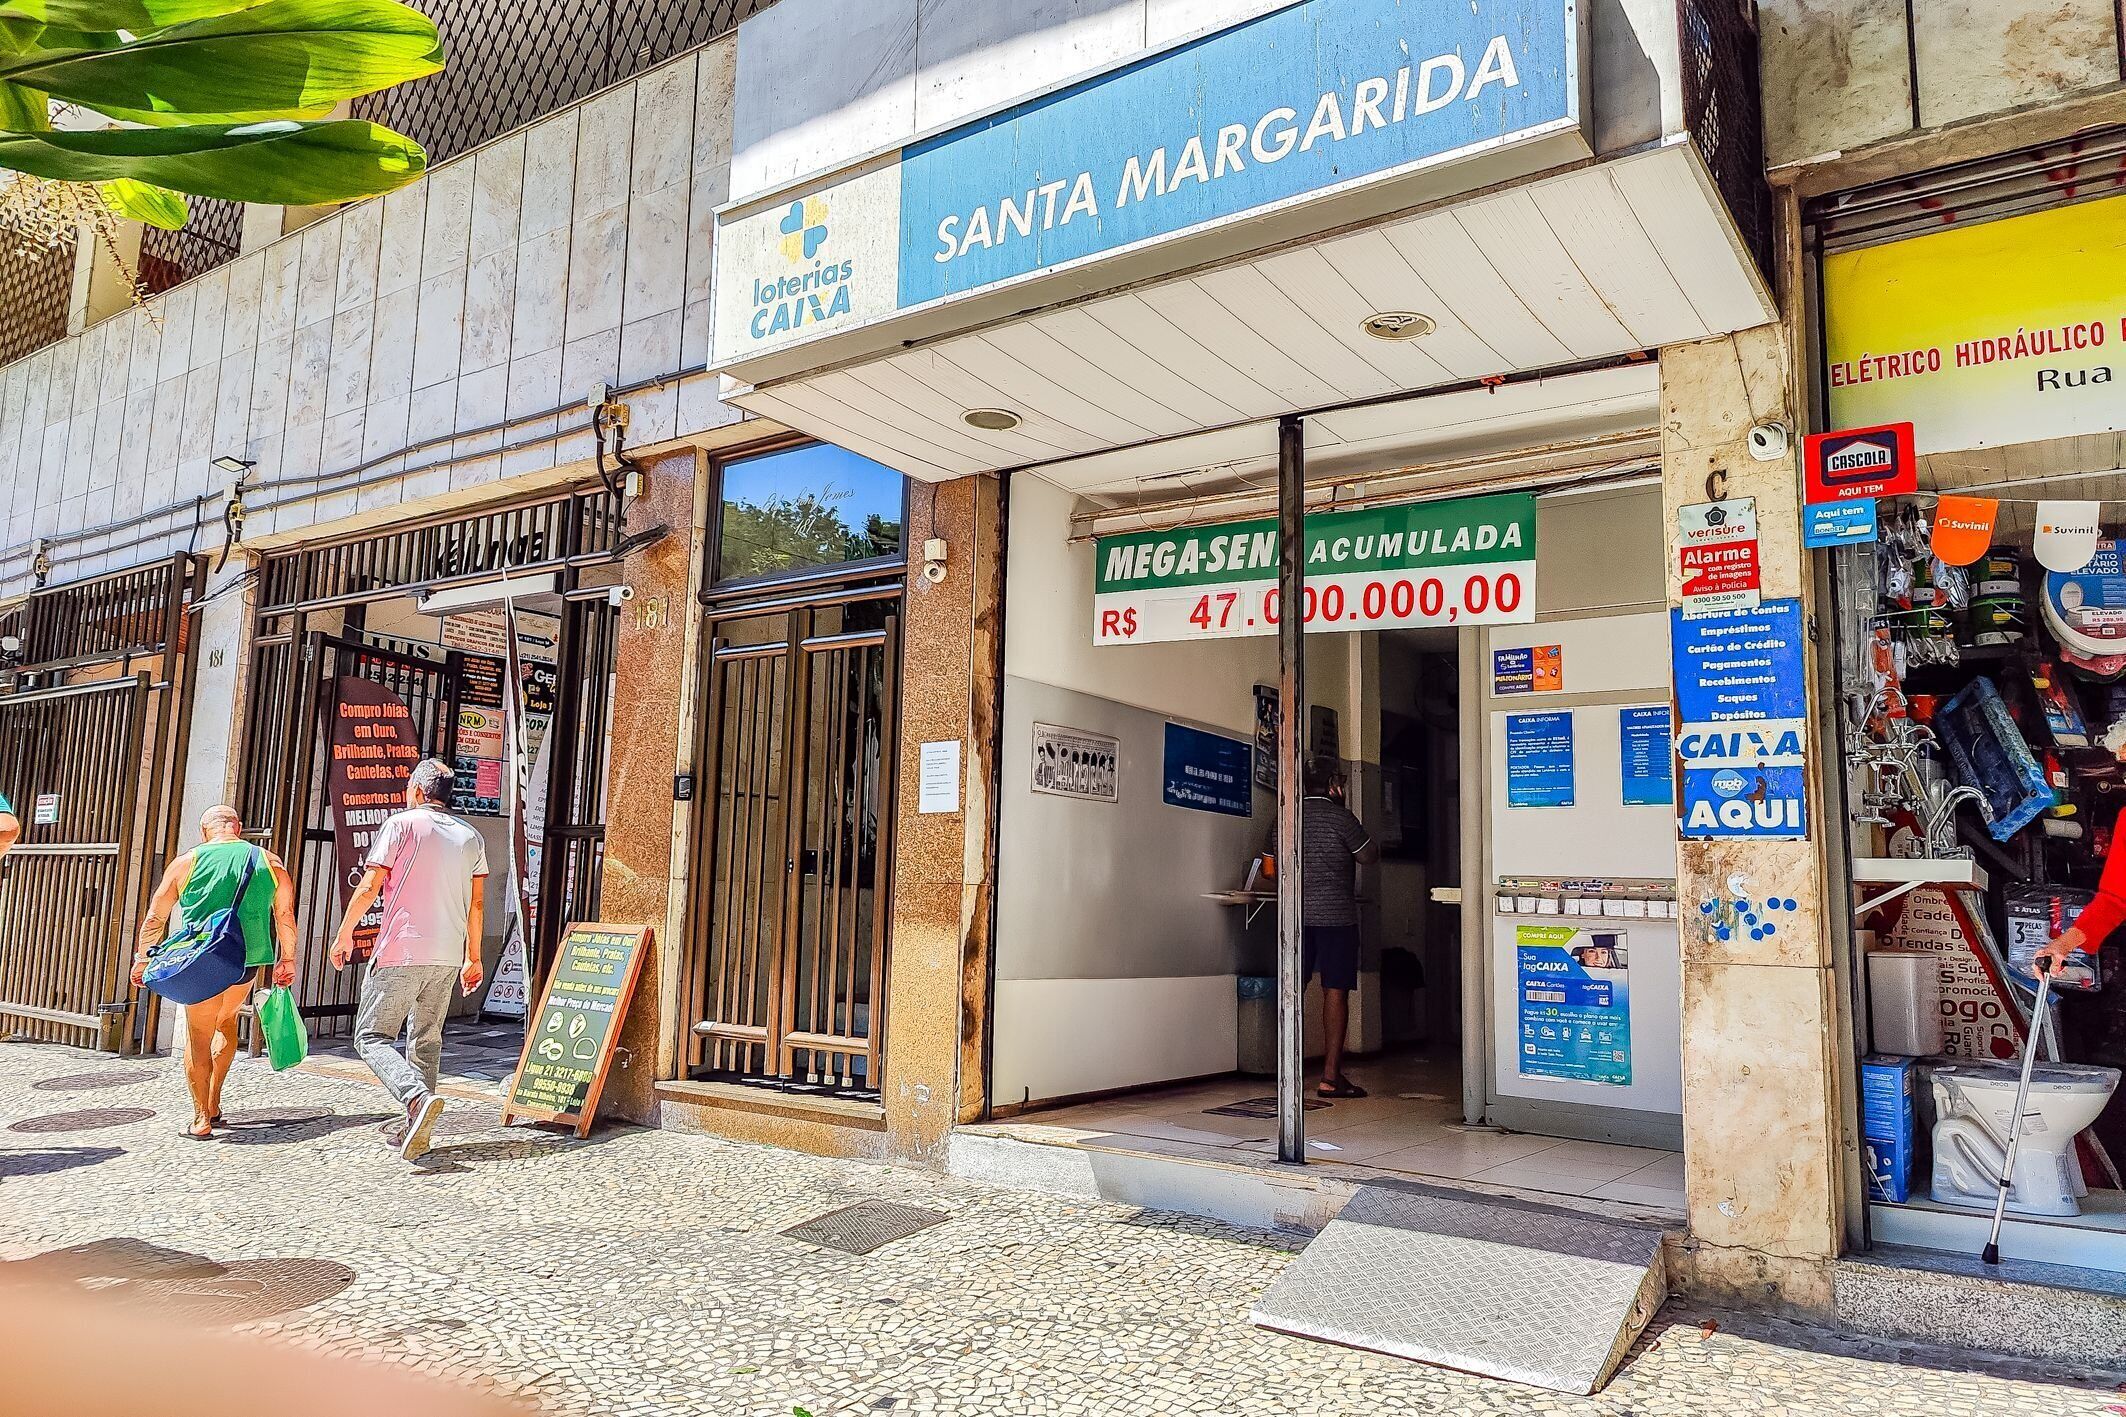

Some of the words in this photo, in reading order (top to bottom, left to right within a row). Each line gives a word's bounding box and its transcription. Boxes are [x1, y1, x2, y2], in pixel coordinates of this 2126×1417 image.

[933, 171, 1099, 264] SANTA
[1115, 34, 1520, 208] MARGARIDA
[753, 258, 853, 306] loterias
[750, 285, 852, 339] CAIXA
[1830, 347, 1941, 388] ELÉTRICO
[1955, 320, 2105, 368] HIDRÁULICO
[2037, 365, 2113, 391] Rua
[1832, 449, 1887, 470] CASCOLA
[1705, 469, 1728, 501] C
[1838, 486, 1862, 497] AQUI
[1863, 484, 1884, 494] TEM
[1815, 509, 1841, 520] Aqui
[1842, 507, 1864, 516] tem
[1688, 523, 1746, 539] verisure
[1951, 520, 1990, 531] Suvinil
[2053, 526, 2094, 535] Suvinil
[1103, 531, 1281, 582] MEGA-SEN
[1308, 521, 1523, 565] ACUMULADA
[1684, 547, 1752, 566] Alarme
[1724, 562, 1752, 572] registro
[1720, 570, 1752, 580] imagens
[1693, 584, 1713, 593] Aviso
[1715, 583, 1720, 591] à
[1722, 580, 1748, 590] Polícia
[634, 596, 669, 630] 181
[1682, 609, 1731, 621] Abertura
[1734, 608, 1749, 617] de
[1752, 605, 1790, 615] Contas
[1101, 606, 1138, 640] R$
[1701, 624, 1772, 637] Empréstimos
[1688, 643, 1725, 654] Cartão
[1727, 642, 1742, 652] de
[1744, 639, 1787, 651] Crédito
[209, 648, 224, 668] 181
[1702, 658, 1772, 671] Pagamentos
[1699, 675, 1777, 687] Recebimentos
[530, 700, 547, 710] Loja
[1718, 694, 1758, 704] Saques
[340, 702, 381, 719] Compro
[383, 703, 409, 718] Jóias
[1711, 709, 1767, 721] Depósitos
[354, 725, 372, 738] em
[373, 723, 398, 739] Ouro,
[474, 730, 502, 741] CONSERTOS
[334, 744, 386, 760] Brilhante,
[386, 744, 420, 759] Pratas,
[457, 744, 474, 753] Loja
[1680, 730, 1801, 759] CAIXA
[346, 765, 395, 780] Cautelas,
[343, 793, 389, 806] Consertos
[390, 793, 402, 804] na
[345, 808, 388, 827] MELHOR
[1687, 799, 1800, 830] AQUI
[353, 831, 369, 848] DO
[1913, 896, 1949, 905] Ombre
[1913, 909, 1958, 922] Cadei
[1911, 927, 1948, 936] Confiança
[2015, 922, 2026, 944] 3
[2025, 922, 2043, 931] PEÇAS
[593, 933, 610, 945] Jóias
[611, 937, 621, 945] em
[622, 937, 635, 947] Our
[1898, 936, 1954, 951] Tendas
[571, 945, 601, 960] Brilhante,
[602, 948, 625, 962] Pratas,
[1523, 953, 1537, 961] Sua
[571, 959, 601, 975] Cautelas,
[601, 964, 615, 975] etc.
[1957, 976, 1990, 985] Profiss
[567, 998, 582, 1011] Preço
[583, 1000, 591, 1009] do
[524, 1062, 544, 1076] Ligue
[544, 1065, 554, 1077] 21
